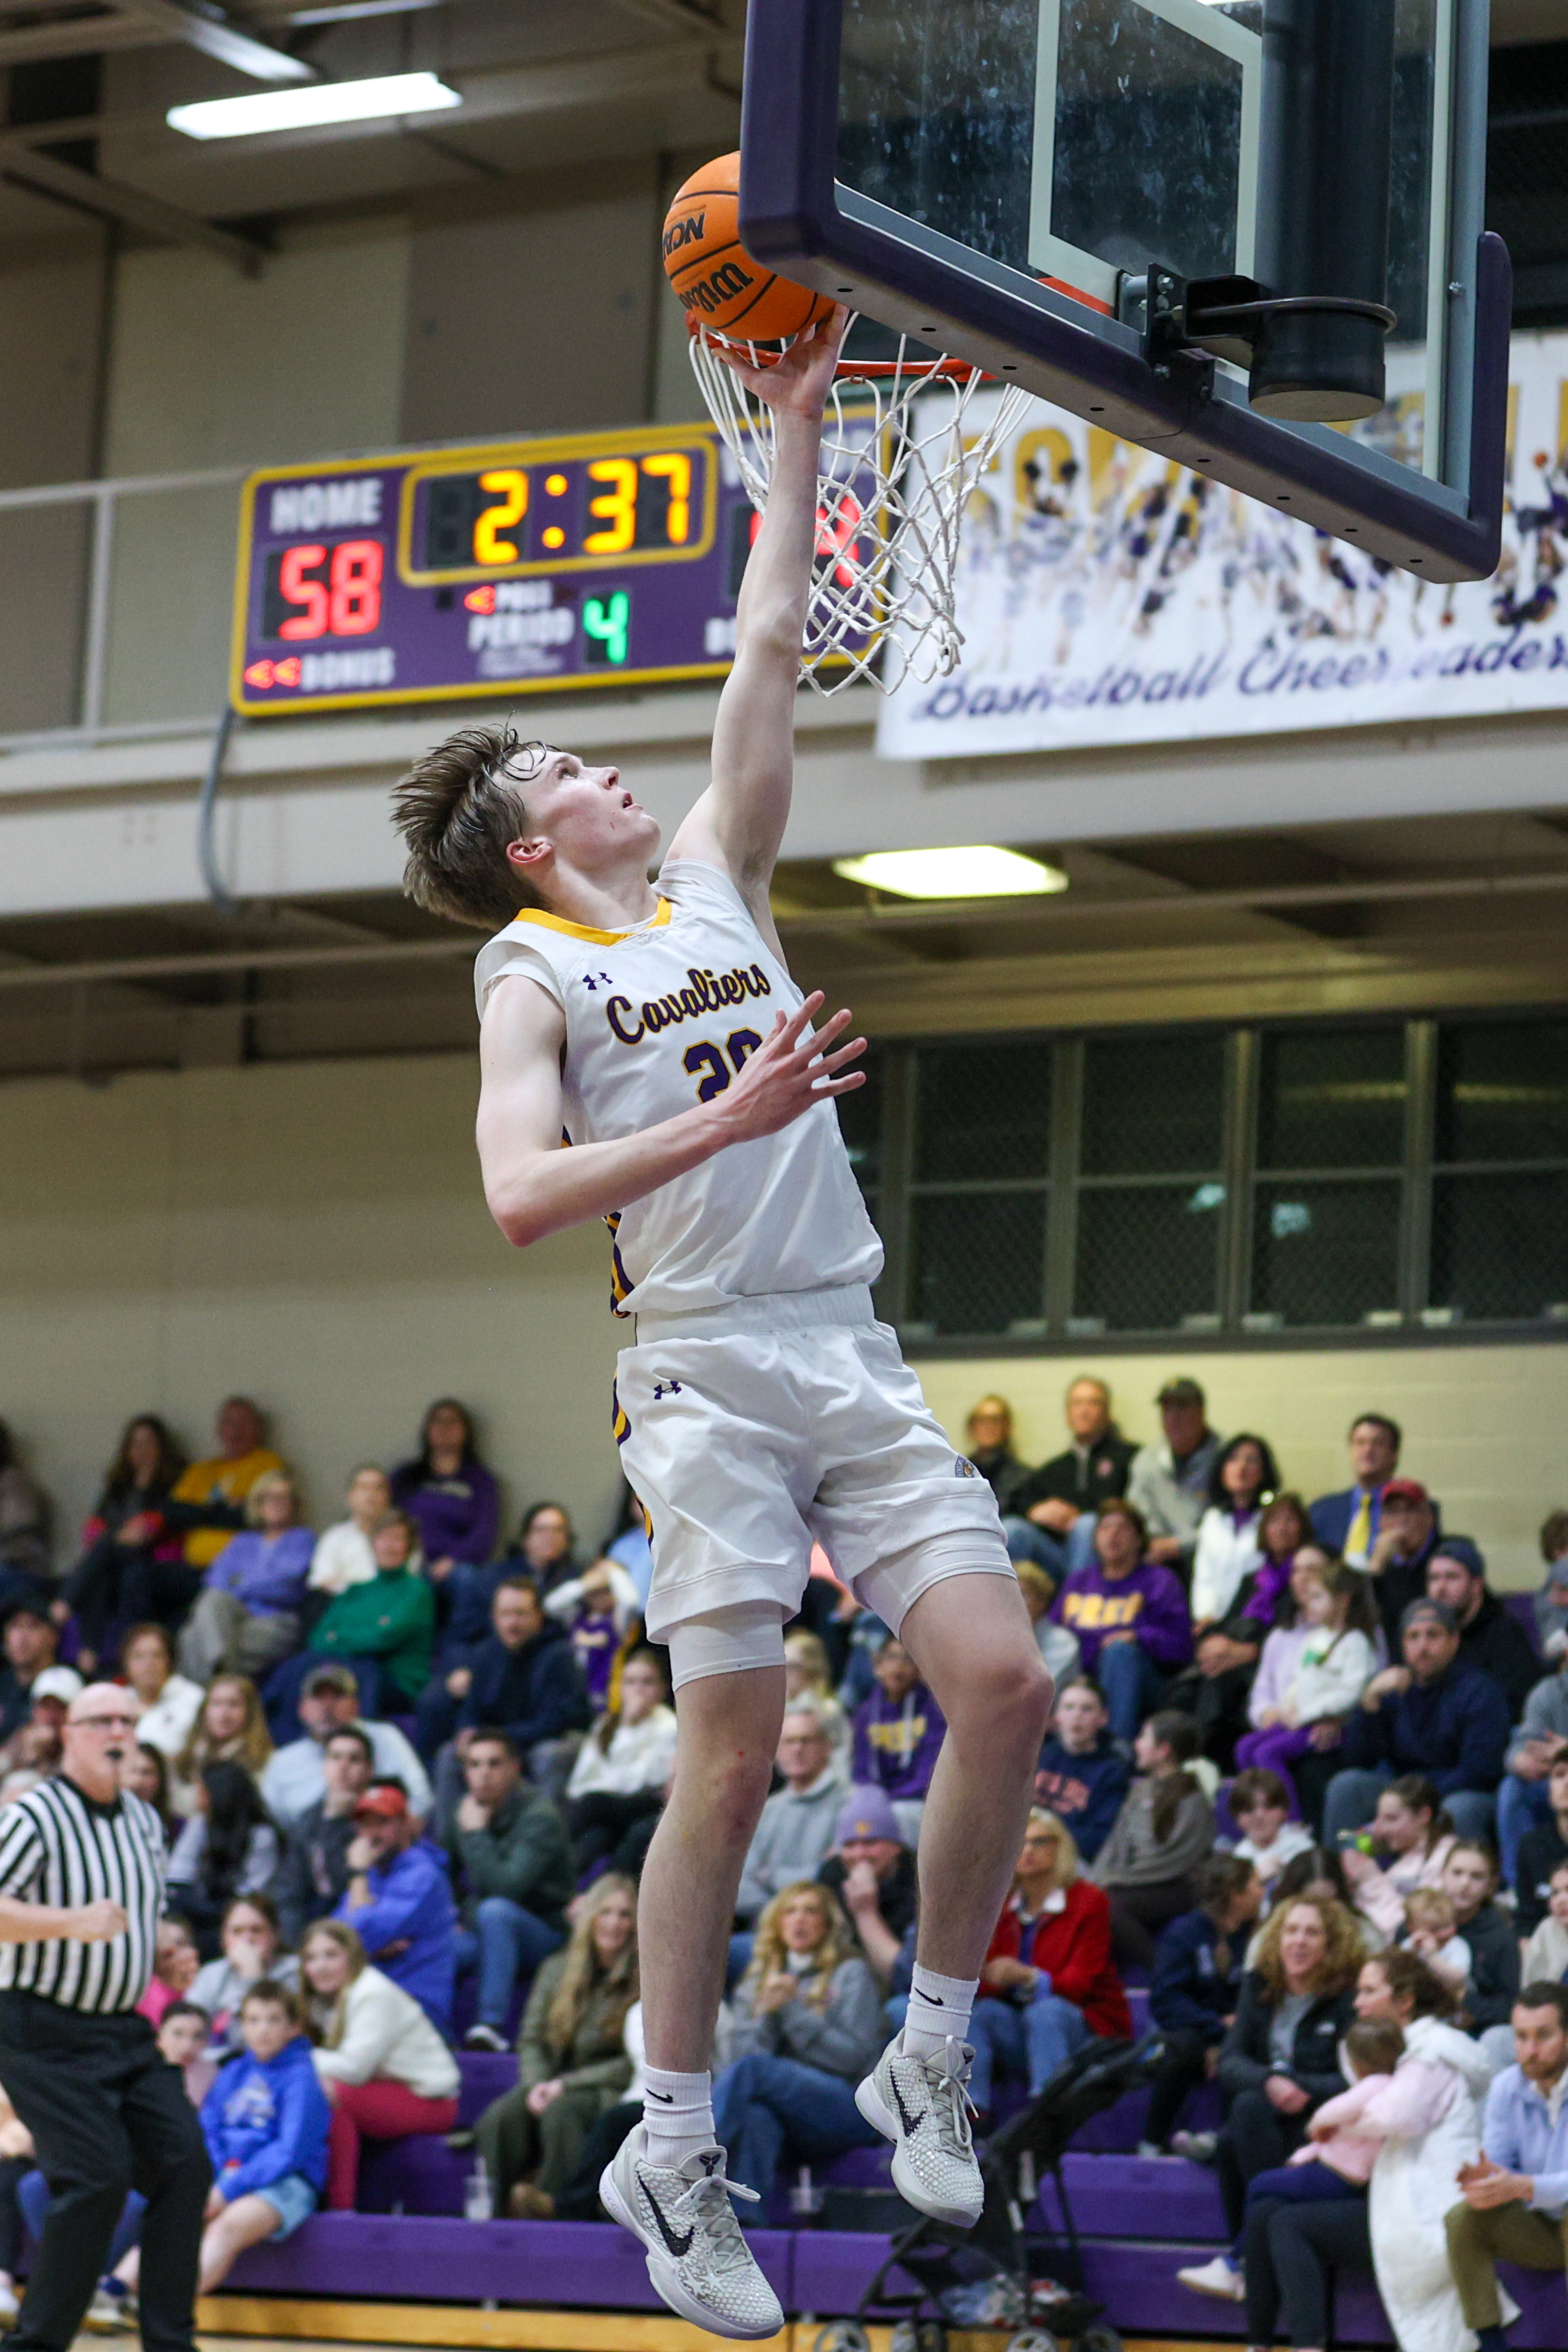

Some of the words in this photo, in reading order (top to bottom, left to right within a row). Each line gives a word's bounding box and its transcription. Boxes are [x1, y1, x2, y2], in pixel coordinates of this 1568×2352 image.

[271, 478, 383, 534] HOME
[474, 453, 690, 566] 2:37
[278, 539, 384, 641] 58
[583, 590, 629, 664] 4
[606, 963, 771, 1045] Cavaliers
